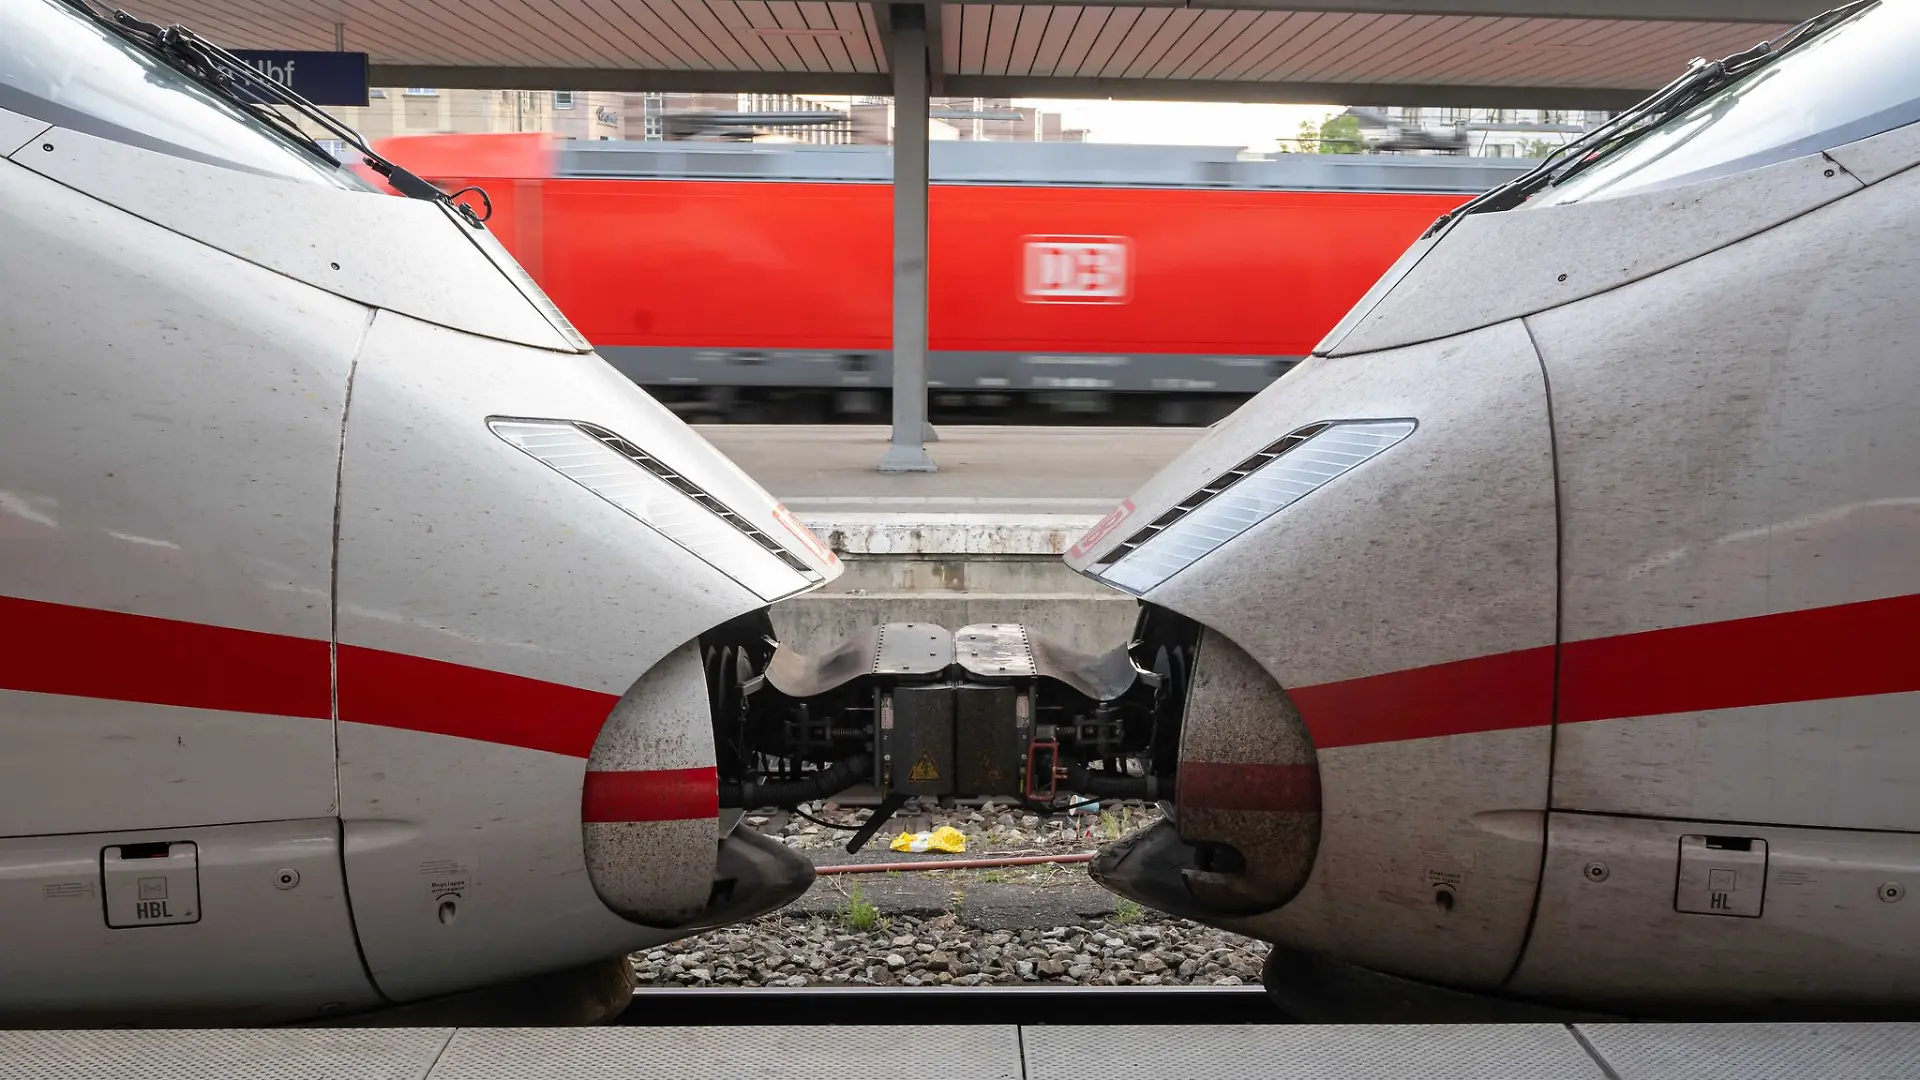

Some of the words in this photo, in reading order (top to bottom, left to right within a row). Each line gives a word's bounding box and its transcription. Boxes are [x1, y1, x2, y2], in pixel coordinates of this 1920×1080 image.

[1027, 244, 1124, 296] DB
[136, 901, 173, 919] HBL
[1710, 892, 1732, 910] HL
